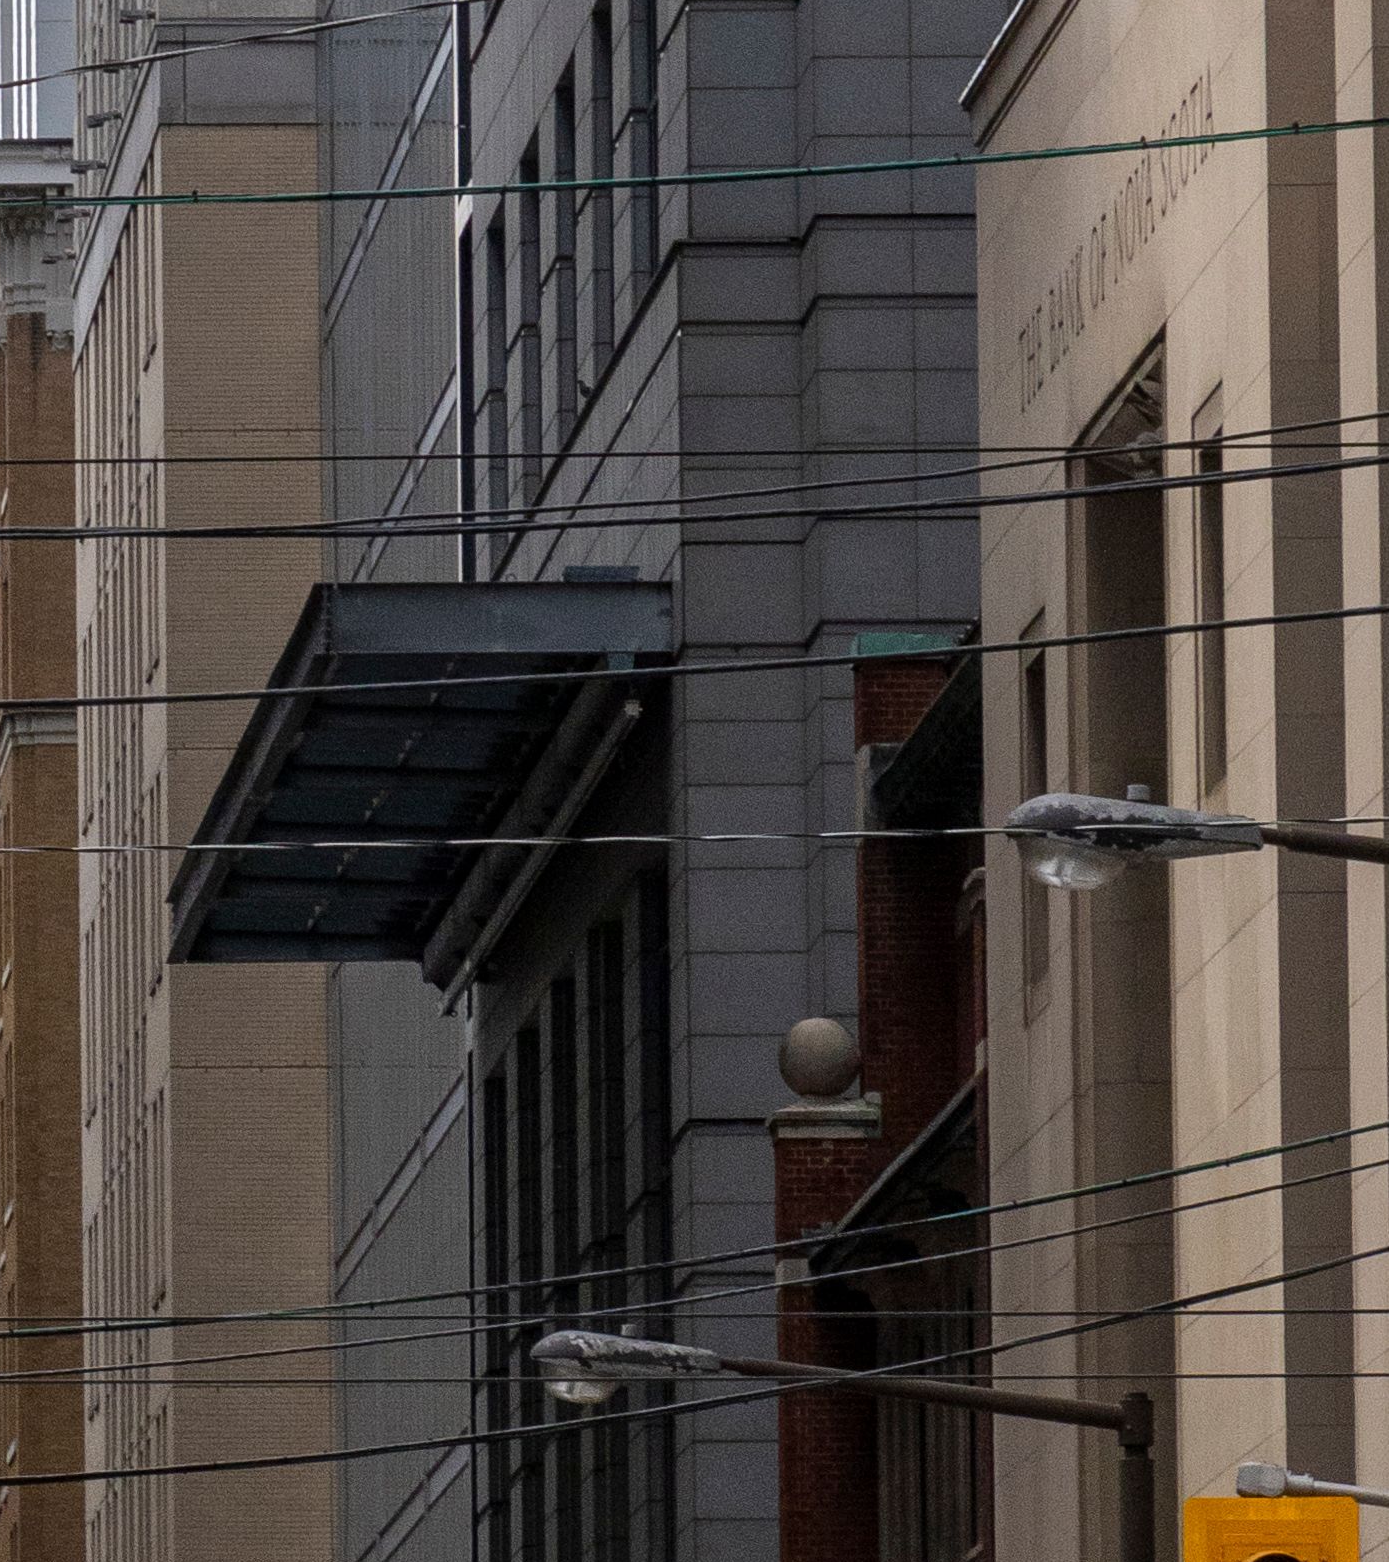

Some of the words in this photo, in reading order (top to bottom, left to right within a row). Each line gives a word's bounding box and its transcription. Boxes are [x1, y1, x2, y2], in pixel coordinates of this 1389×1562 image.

[1018, 304, 1043, 414] THE
[1049, 244, 1085, 375] BANK
[1089, 214, 1106, 310] OF
[1114, 141, 1155, 285] NOVA
[1160, 60, 1215, 218] SCOTIA
